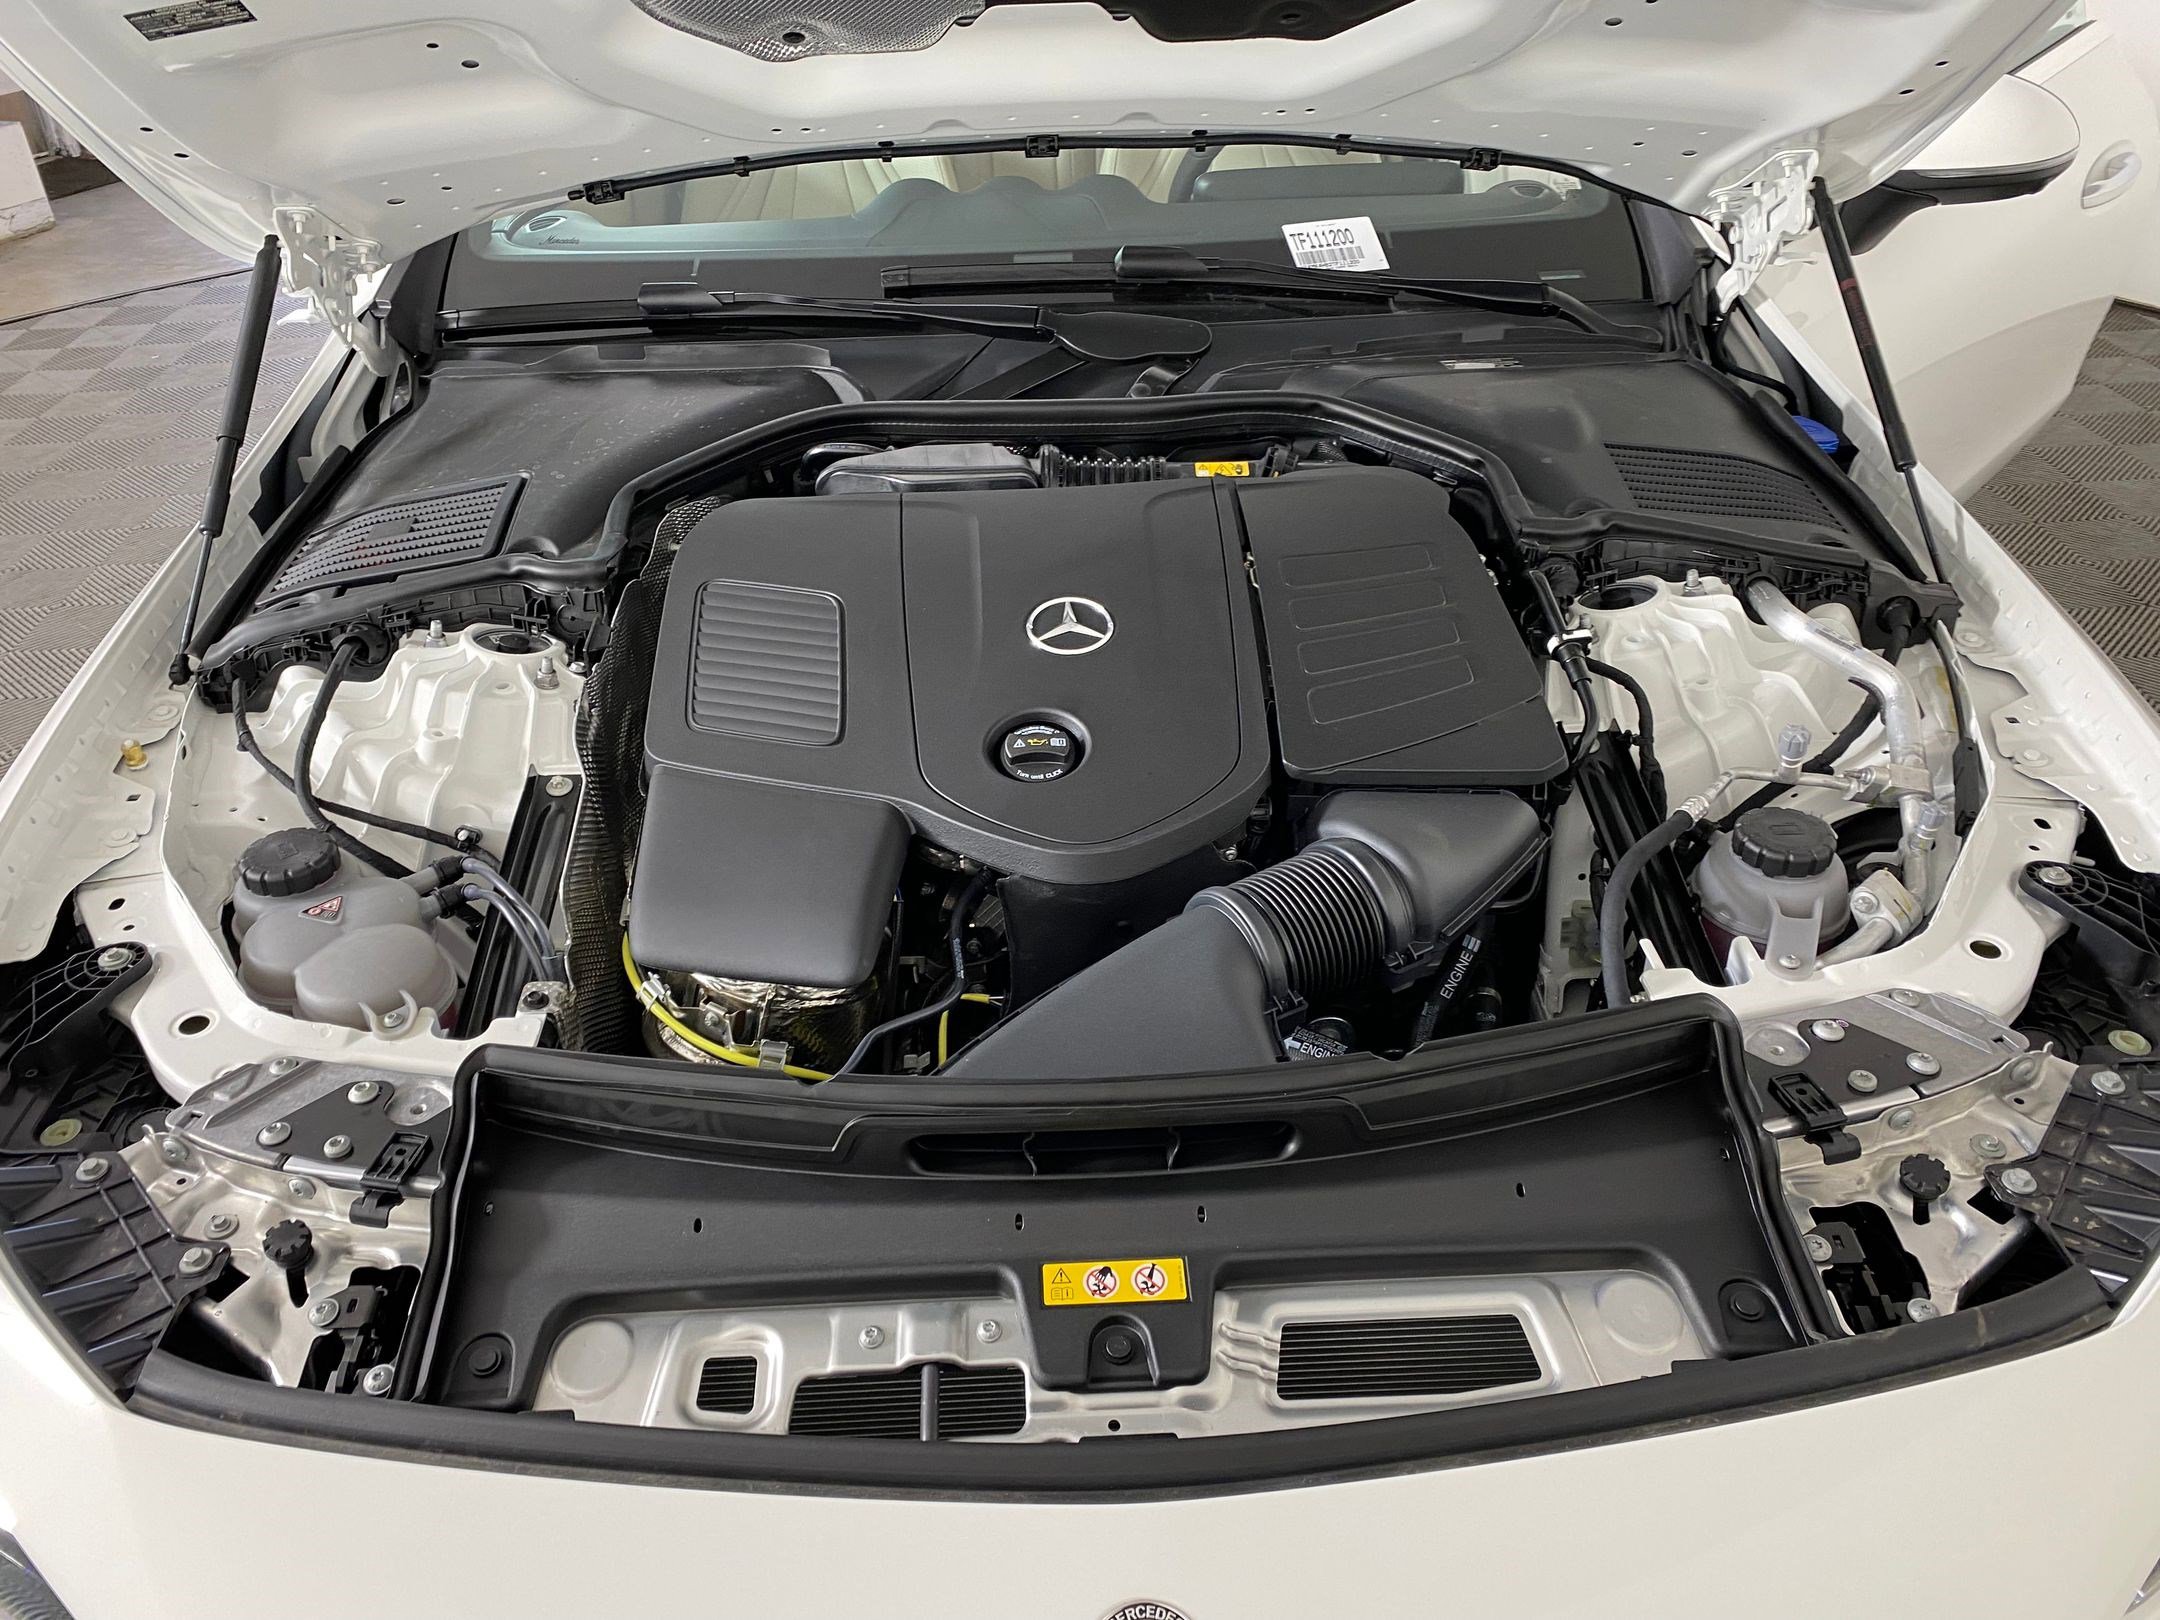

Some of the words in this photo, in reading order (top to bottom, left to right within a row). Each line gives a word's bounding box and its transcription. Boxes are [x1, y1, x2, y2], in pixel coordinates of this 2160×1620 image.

[1289, 227, 1355, 251] TF111200
[1016, 769, 1030, 779] Turn
[1045, 768, 1064, 779] CLICK
[1440, 950, 1474, 1000] ENGINE
[1300, 1041, 1338, 1059] ENGI
[1108, 1605, 1184, 1620] ERCEDE
